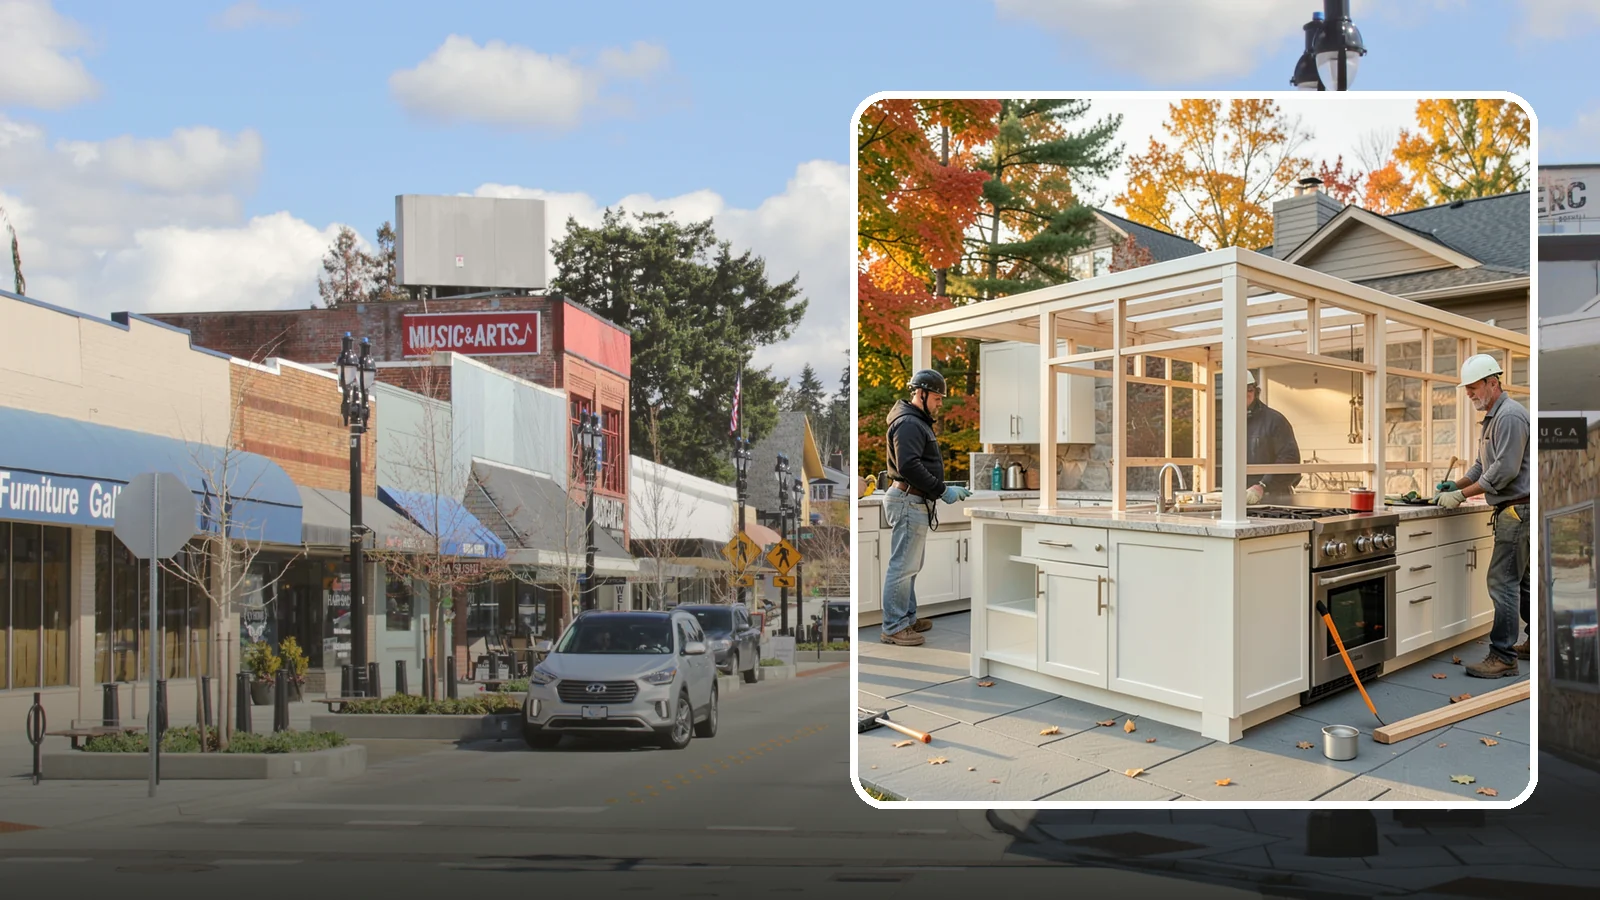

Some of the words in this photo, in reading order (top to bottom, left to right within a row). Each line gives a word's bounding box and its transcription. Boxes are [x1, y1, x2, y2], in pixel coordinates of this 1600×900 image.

[1540, 427, 1577, 436] UGA
[0, 471, 79, 515] Furniture
[90, 482, 121, 519] Gal
